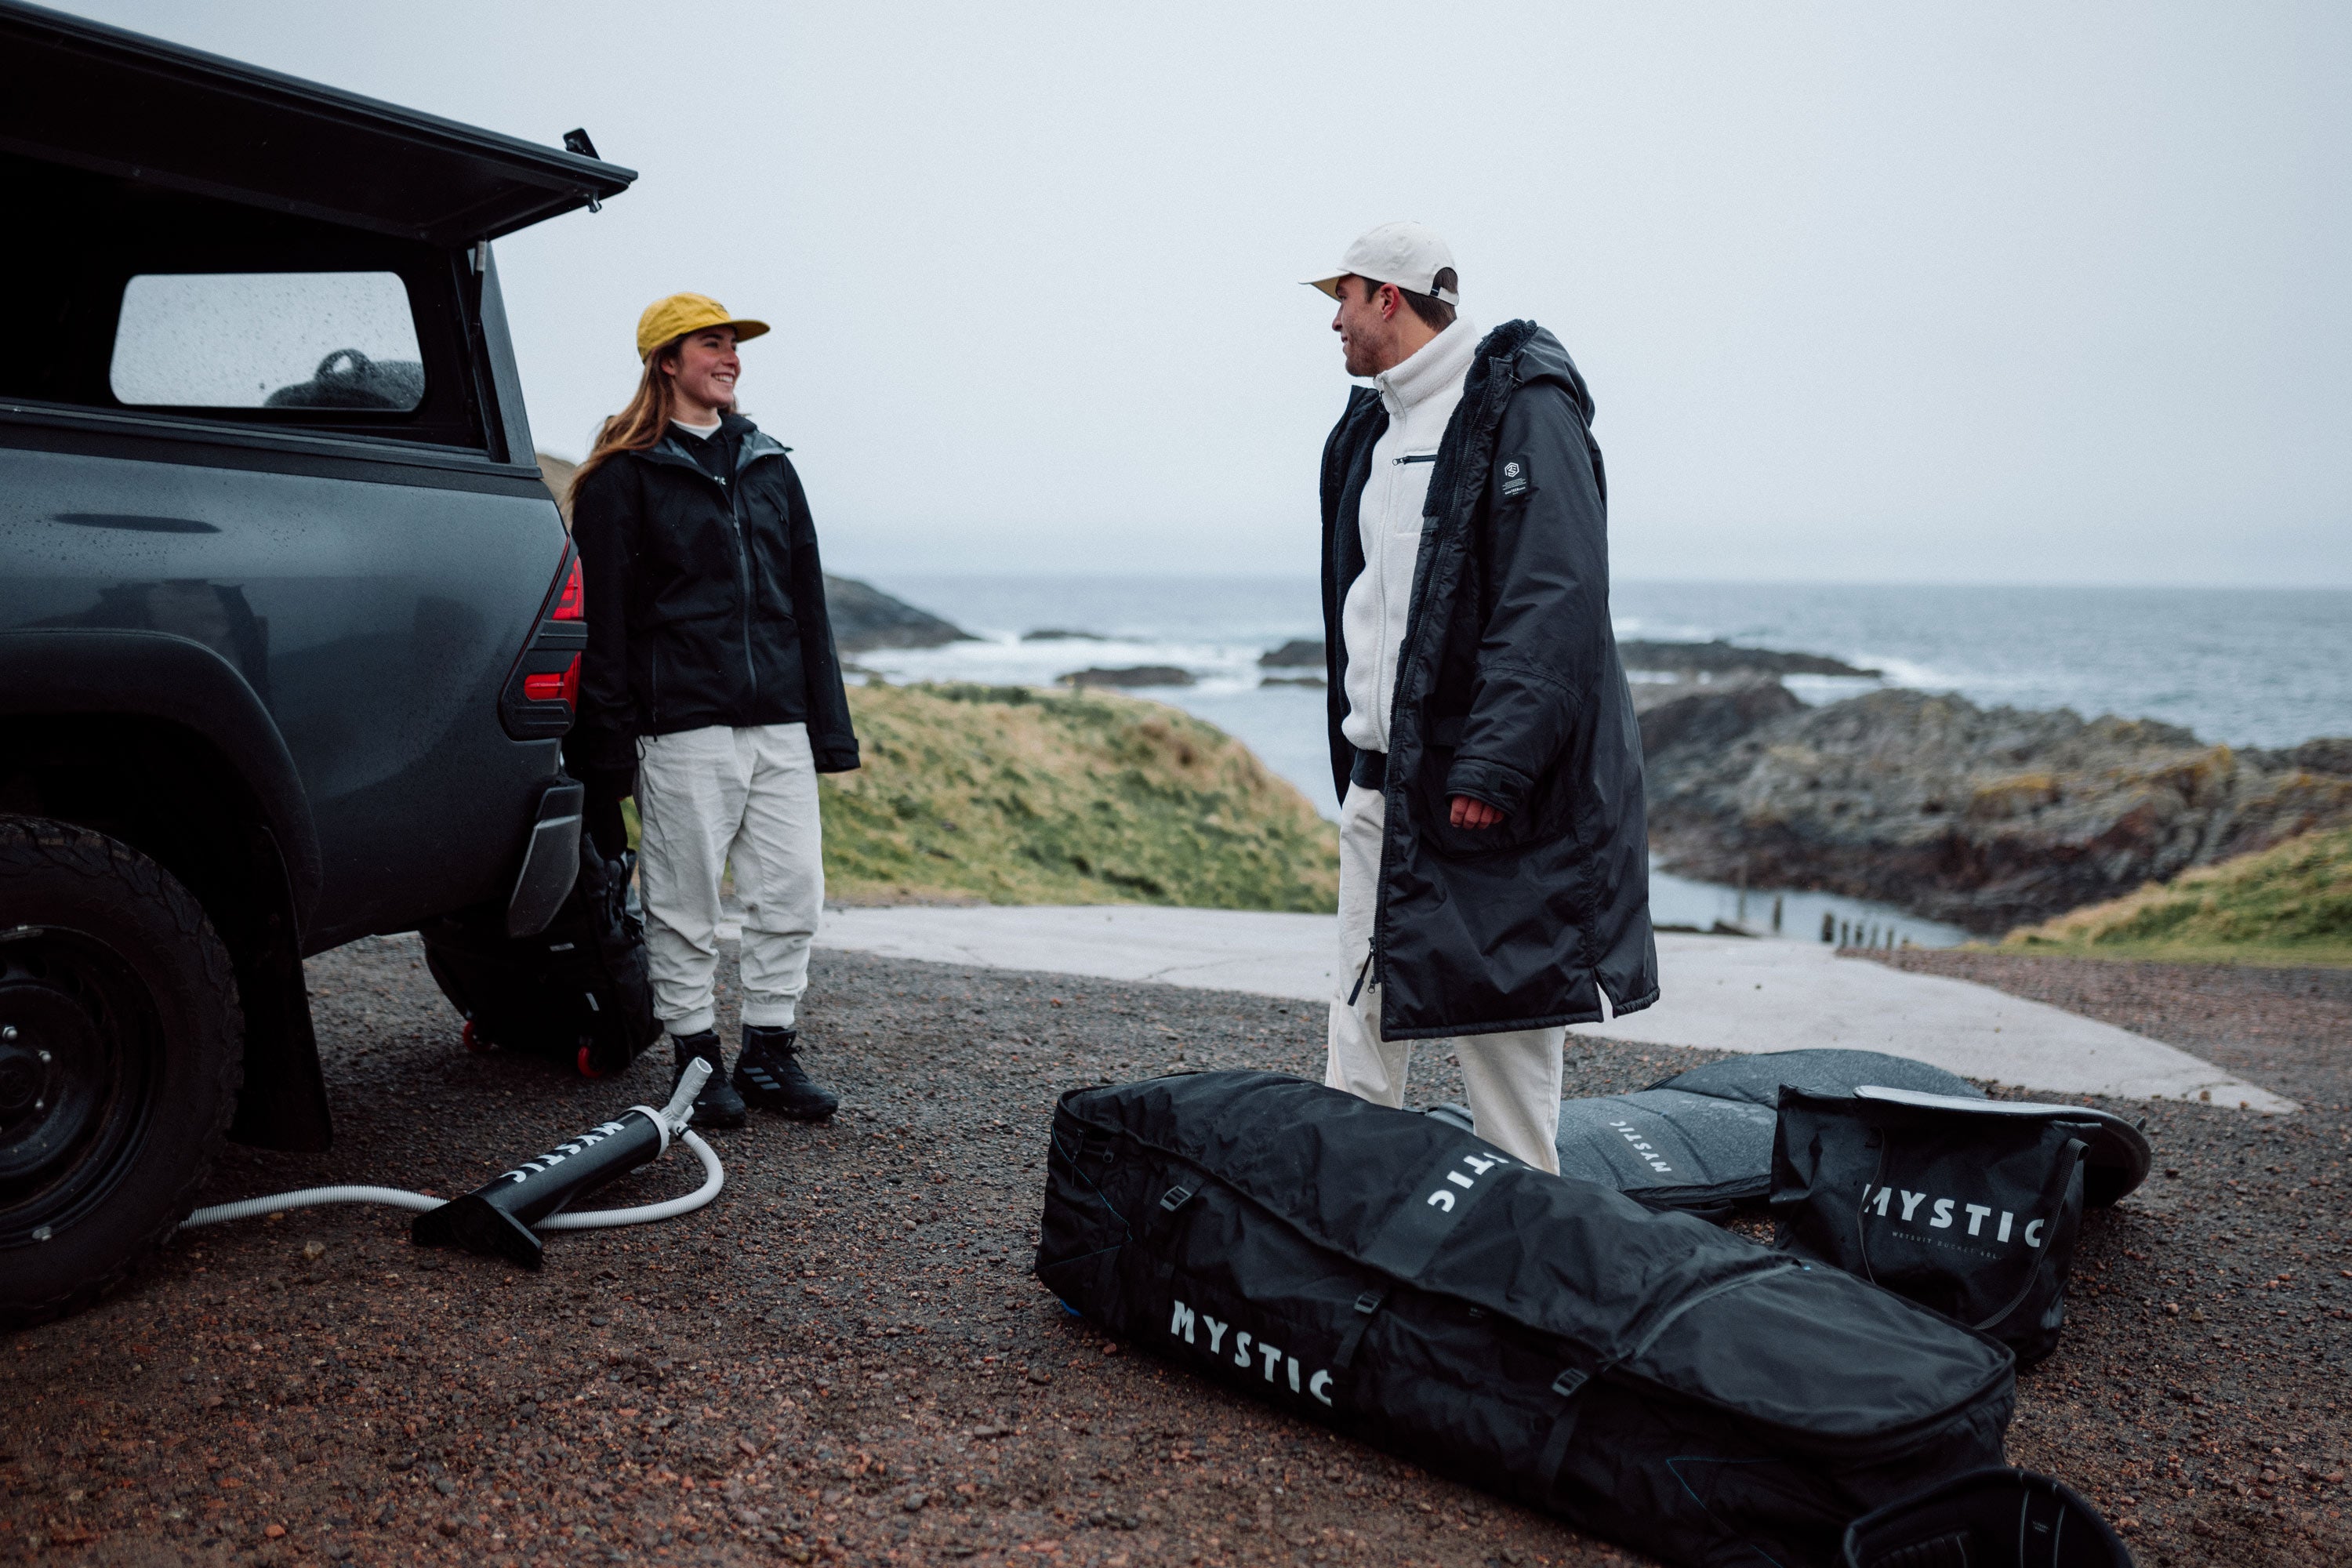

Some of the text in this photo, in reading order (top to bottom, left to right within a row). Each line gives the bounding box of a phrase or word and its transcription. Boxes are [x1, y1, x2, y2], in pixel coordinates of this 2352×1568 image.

[499, 1121, 626, 1183] MYSTIC
[1609, 1120, 1672, 1172] MYSTIC
[1427, 1152, 1535, 1213] TIC
[1892, 1231, 1933, 1243] WETSUIT
[1937, 1240, 1974, 1254] BUCKET
[1171, 1299, 1334, 1409] MYSTIC
